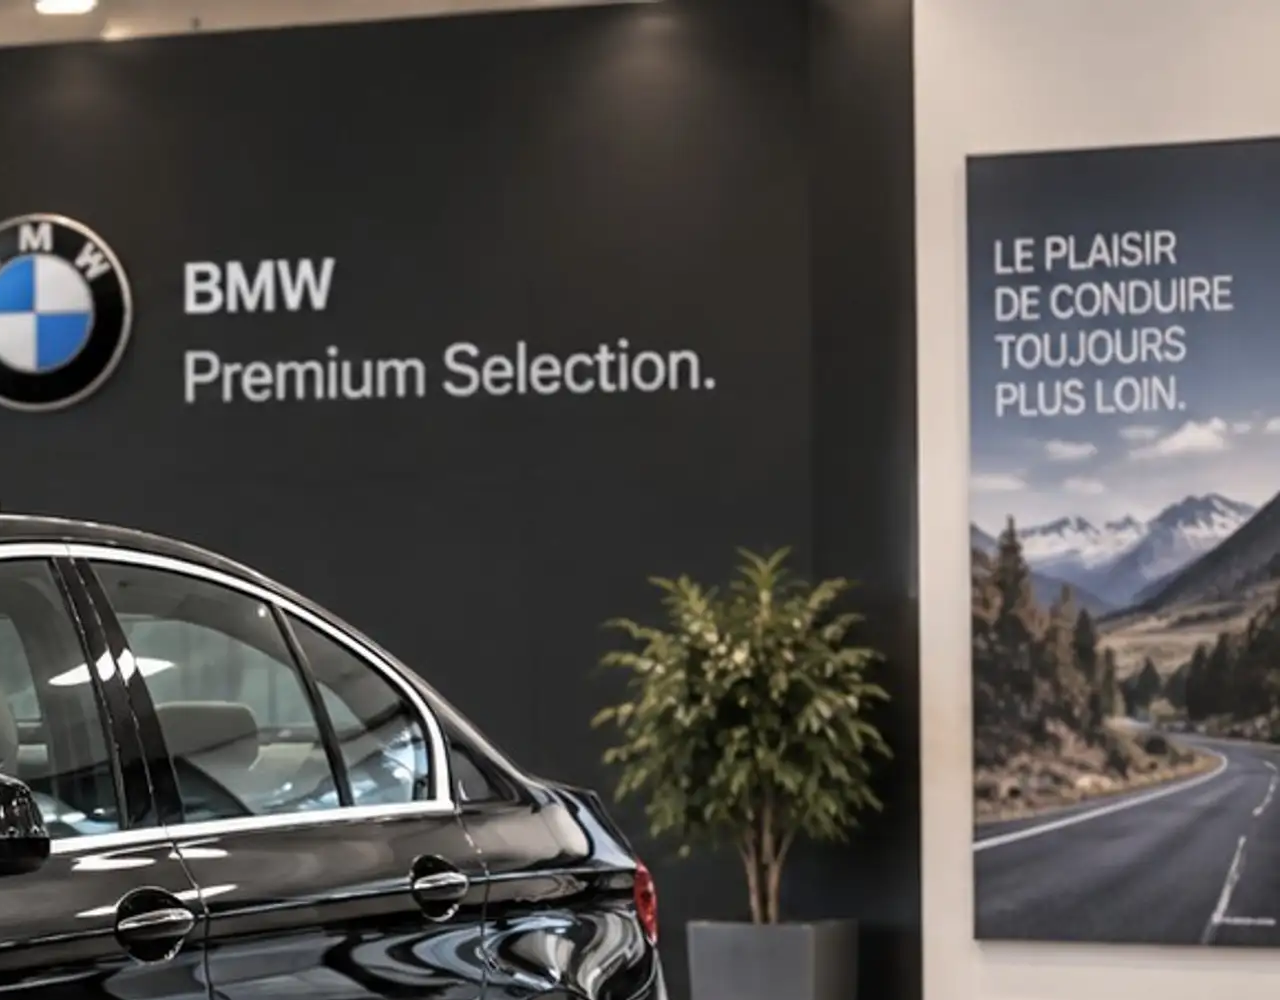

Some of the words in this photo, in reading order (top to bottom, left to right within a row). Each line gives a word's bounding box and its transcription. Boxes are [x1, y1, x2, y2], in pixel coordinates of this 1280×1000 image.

[994, 238, 1035, 275] LE
[1045, 230, 1177, 271] PLAISIR
[184, 257, 336, 315] BMW
[994, 285, 1041, 322] DE
[1049, 275, 1234, 320] CONDUIRE
[994, 325, 1188, 370] TOUJOURS
[184, 344, 426, 404] Premium
[443, 338, 716, 398] Selection.
[994, 378, 1086, 418] PLUS
[1095, 374, 1188, 415] LOIN.
